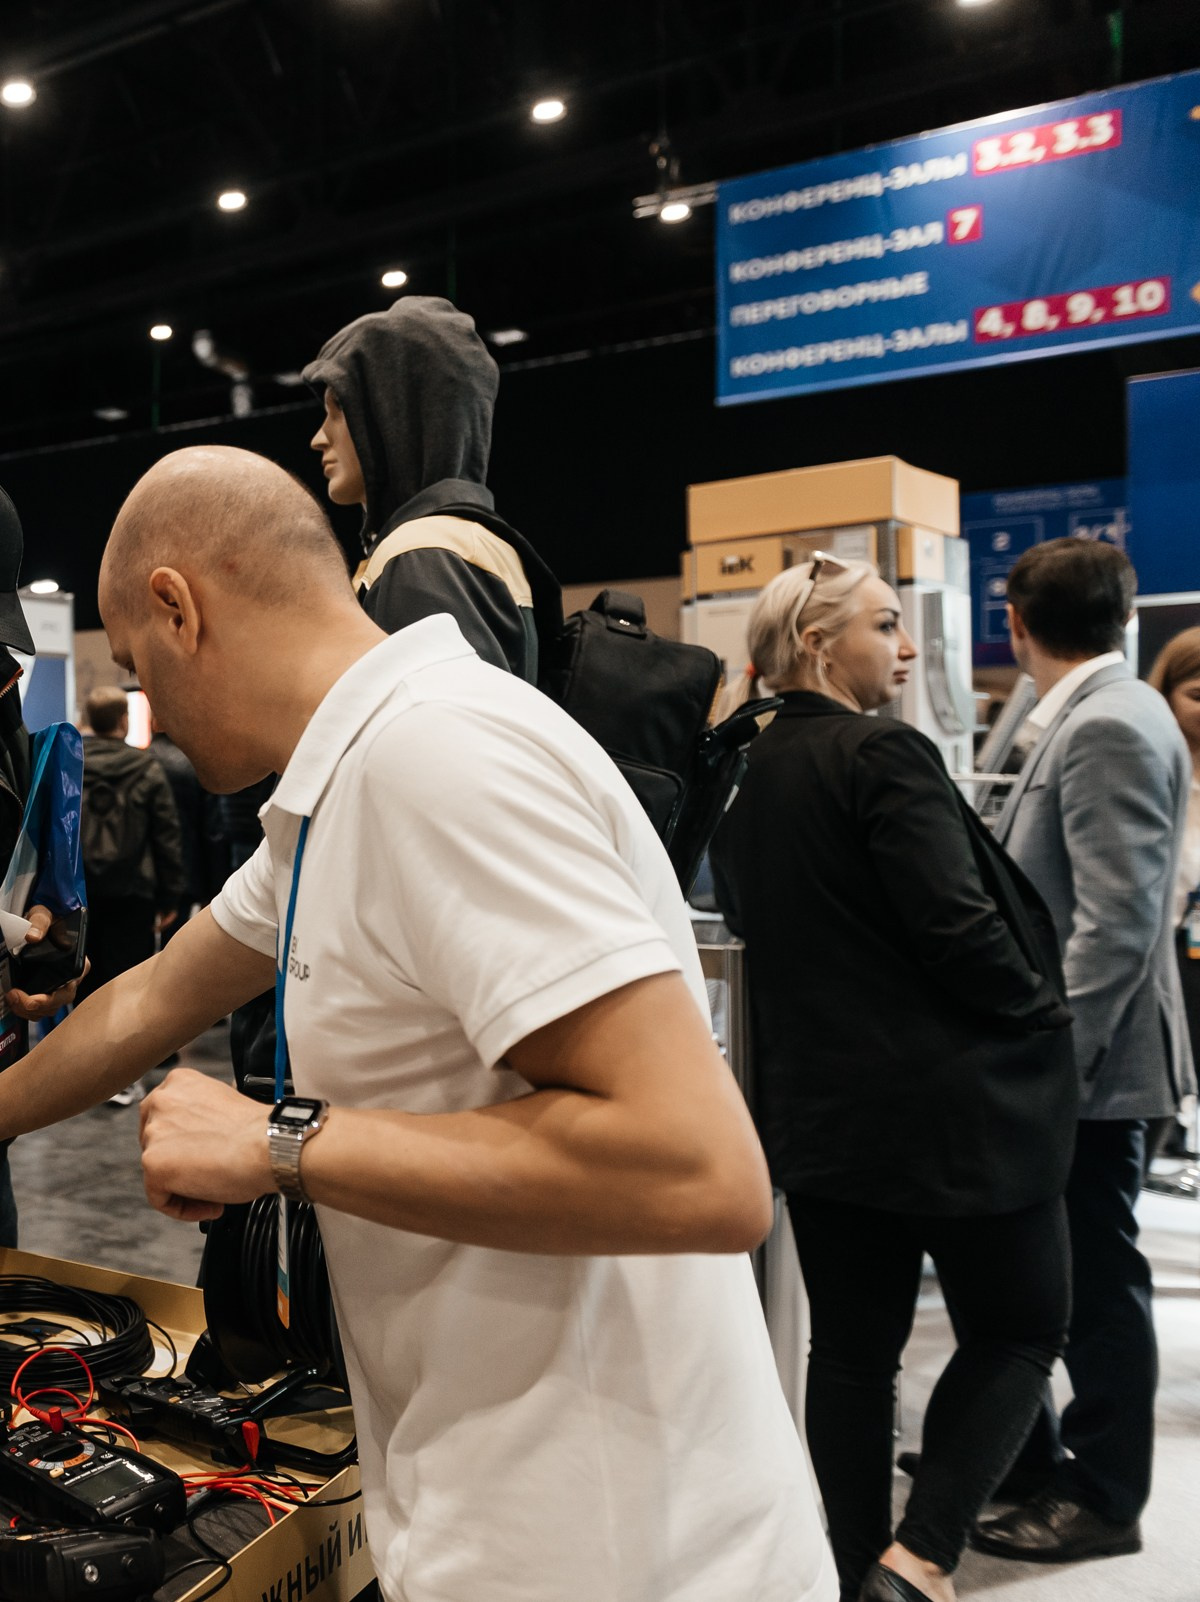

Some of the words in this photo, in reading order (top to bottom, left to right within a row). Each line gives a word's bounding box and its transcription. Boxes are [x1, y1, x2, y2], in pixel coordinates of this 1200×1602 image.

[728, 152, 968, 225] КОНФЕРЕНЦ-ЗАЛЫ
[975, 131, 1046, 172] 3.2,
[1052, 113, 1114, 154] 3.3
[729, 221, 943, 284] КОНФЕРЕНЦ-ЗАЛ
[951, 207, 979, 241] 7
[730, 271, 929, 327] ПЕРЕГОВОРНЫЕ
[730, 319, 968, 378] КОНФЕРЕНЦ-ЗАЛЫ
[1112, 280, 1165, 316] 10
[348, 1512, 368, 1557] И
